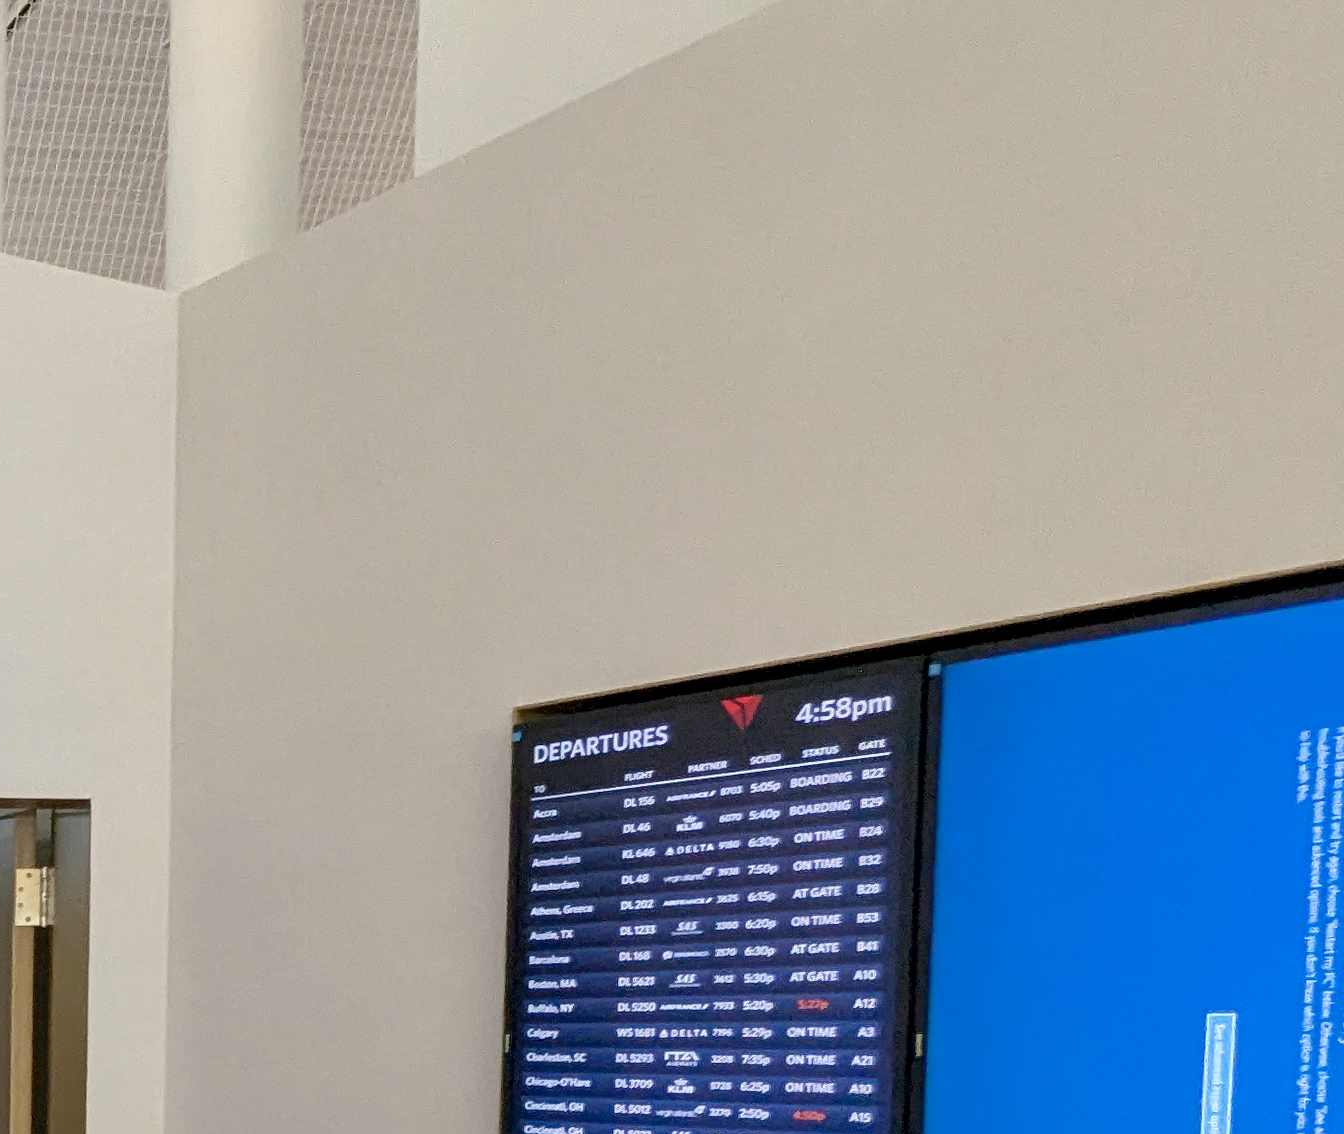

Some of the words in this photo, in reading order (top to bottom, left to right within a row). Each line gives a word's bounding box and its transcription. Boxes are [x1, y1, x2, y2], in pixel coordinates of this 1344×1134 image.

[795, 695, 892, 724] 4:58pm
[533, 725, 668, 764] DEPARTURES
[534, 785, 546, 793] TO
[687, 760, 728, 774] PARTNER
[802, 745, 840, 759] STATUS
[858, 738, 887, 751] GATE
[623, 797, 637, 808] DL
[790, 771, 853, 789] BOARDING
[622, 823, 637, 834] DL
[636, 822, 651, 832] 46
[789, 799, 852, 817] BOARDING
[622, 849, 635, 859] KL
[677, 843, 715, 855] DELTA
[793, 832, 814, 844] ON
[813, 828, 845, 842] TIME
[621, 875, 636, 885] DL
[634, 873, 650, 884] 48
[792, 860, 813, 871] ON
[812, 857, 843, 869] TIME
[620, 900, 635, 911] DL
[792, 887, 810, 899] AT
[809, 885, 842, 898] GATE
[619, 926, 634, 936] DL
[790, 916, 810, 927] ON
[810, 913, 842, 926] TIME
[618, 951, 633, 961] DL
[790, 943, 808, 954] AT
[807, 942, 840, 954] GATE
[617, 977, 632, 987] DL
[789, 971, 806, 982] AT
[806, 970, 839, 982] GATE
[853, 969, 877, 980] A10
[617, 1002, 631, 1012] DL
[670, 1029, 708, 1038] DELTA
[786, 1026, 807, 1038] ON
[806, 1026, 837, 1038] TIME
[857, 1026, 875, 1038] A3
[615, 1053, 630, 1063] DL
[785, 1054, 805, 1065] ON
[805, 1054, 836, 1066] TIME
[614, 1078, 629, 1089] DL
[785, 1081, 804, 1093] ON
[804, 1082, 835, 1094] TIME
[614, 1103, 628, 1114] DL
